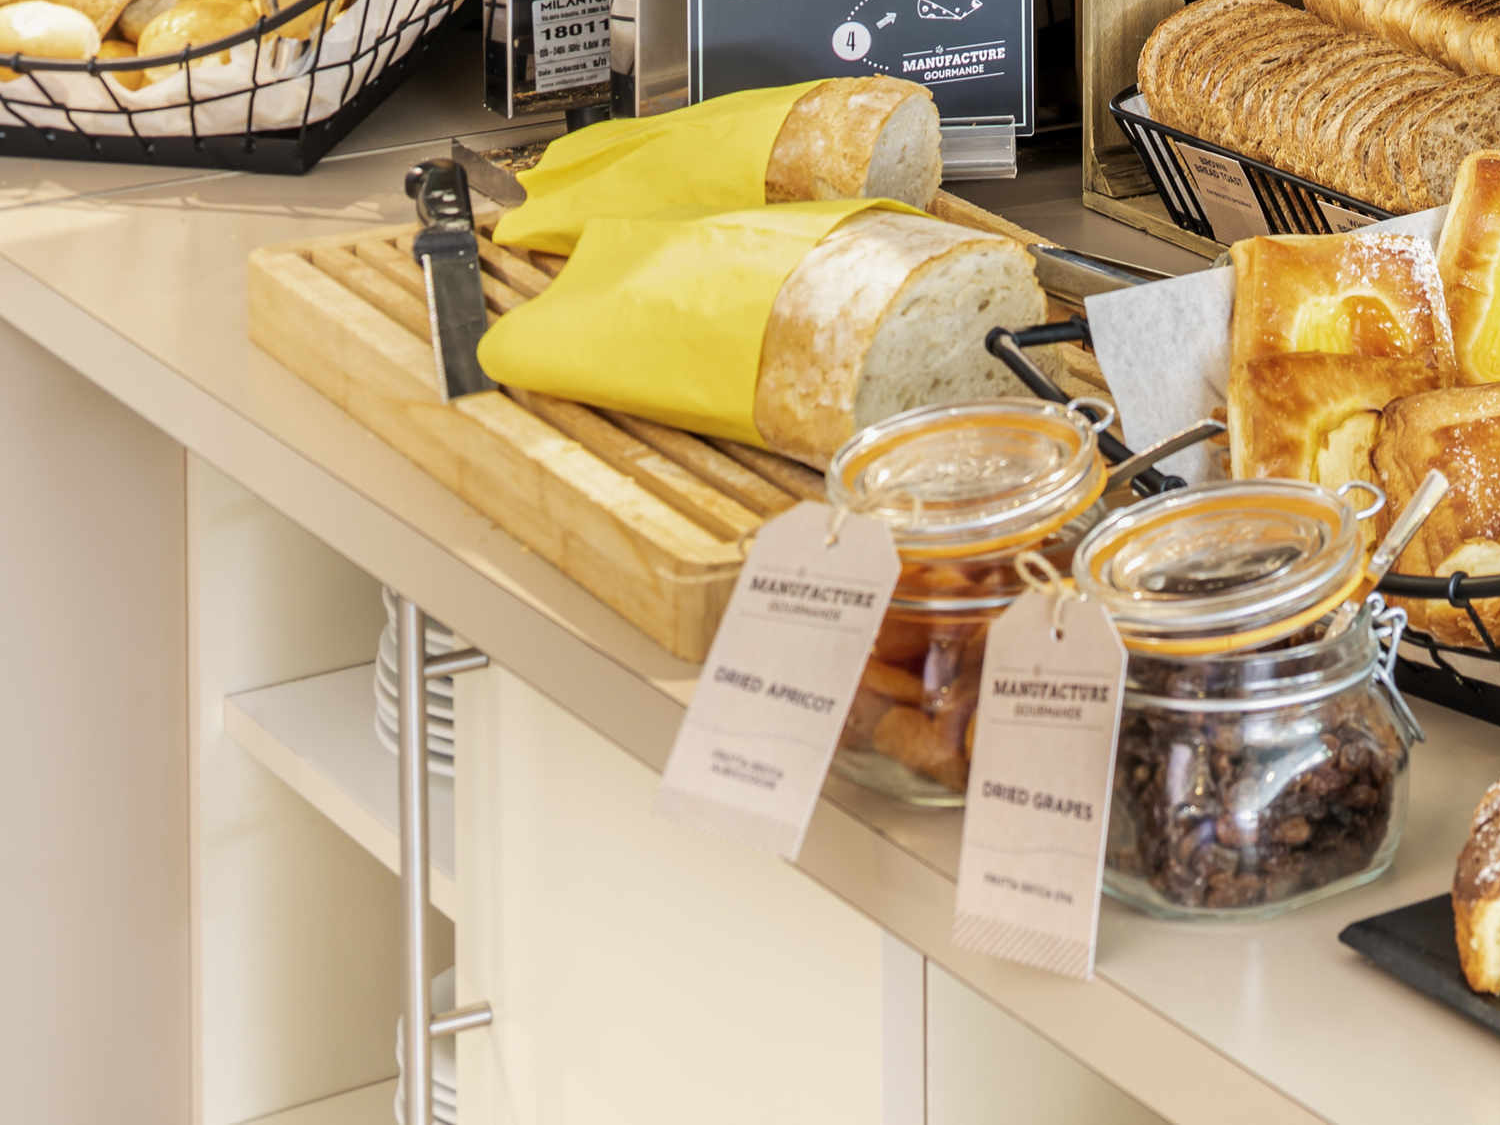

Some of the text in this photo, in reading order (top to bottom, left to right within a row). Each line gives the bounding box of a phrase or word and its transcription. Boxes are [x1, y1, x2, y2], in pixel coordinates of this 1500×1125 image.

[846, 30, 855, 52] 4
[902, 47, 1006, 73] MANUFACTURE
[923, 64, 985, 81] GOURMANDE
[750, 577, 876, 609] MANUFACTURE
[714, 666, 836, 715] DRIED APRICOT
[992, 679, 1110, 703] MANUFACTURE
[982, 781, 1093, 822] DRIED GRAPES
